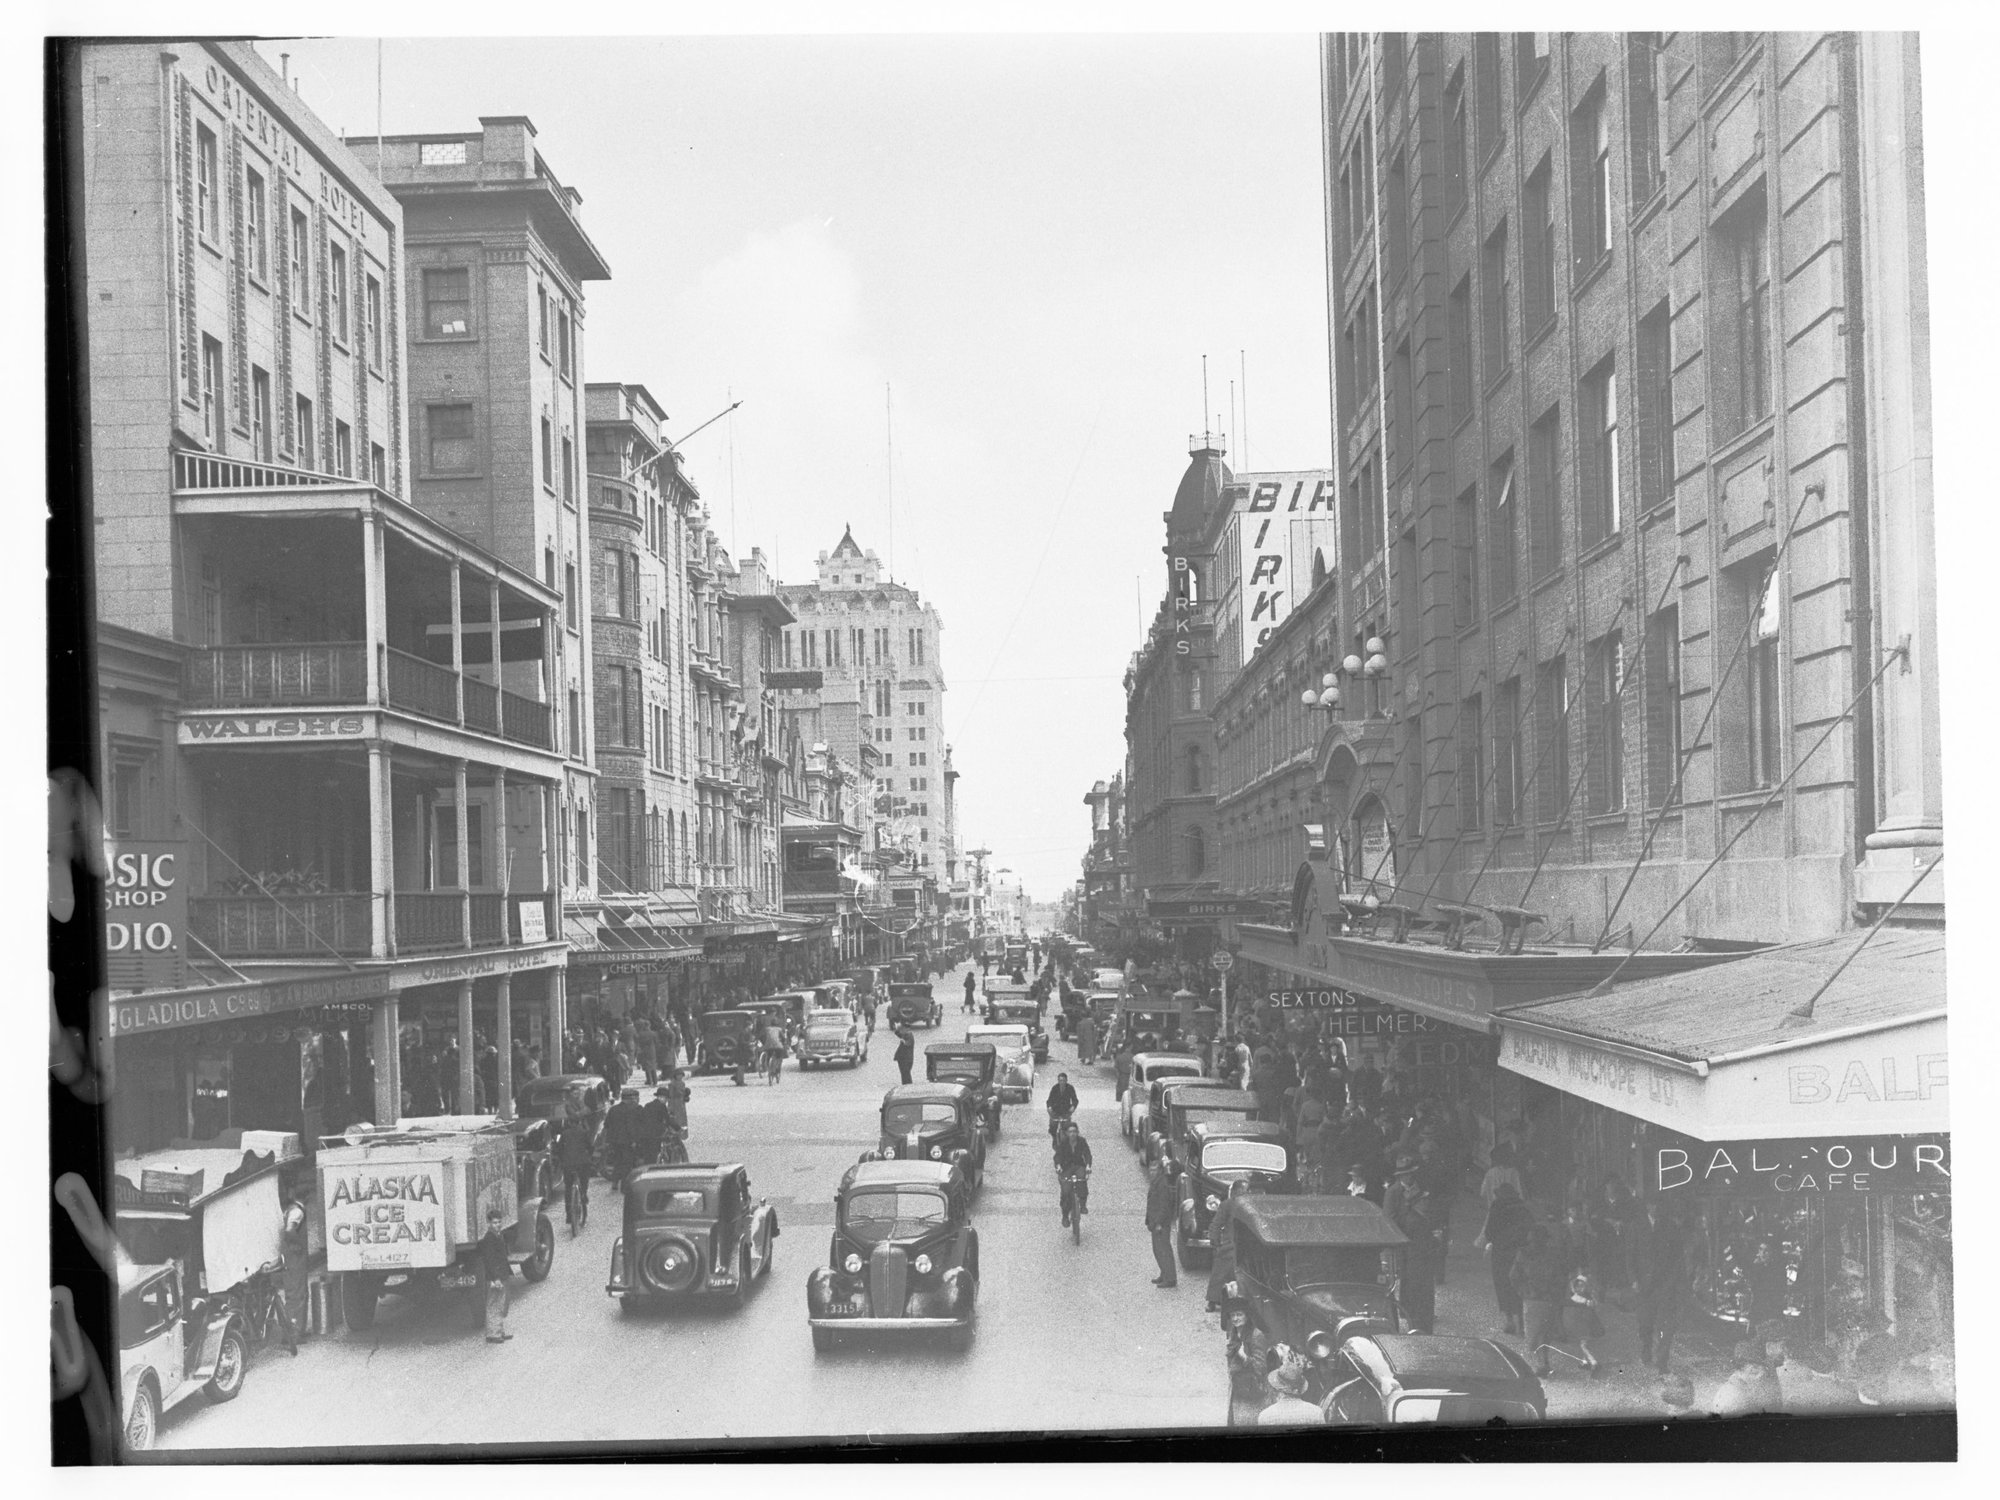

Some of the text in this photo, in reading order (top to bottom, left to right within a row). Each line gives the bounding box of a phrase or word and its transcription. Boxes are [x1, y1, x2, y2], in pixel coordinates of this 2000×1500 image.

[206, 65, 366, 238] ORIENTAL HOTEL
[1174, 557, 1190, 655] BIRKS
[1189, 904, 1237, 914] BIRKS
[422, 951, 547, 980] ORIENTAL HOTEL
[1269, 990, 1356, 1008] SEXTONS
[120, 998, 218, 1030] GLADIOLA
[1788, 1053, 1949, 1104] BALF
[328, 1174, 439, 1210] ALASKA
[1774, 1173, 1871, 1191] CAFE
[363, 1203, 405, 1224] ICE
[332, 1217, 436, 1246] CREAM
